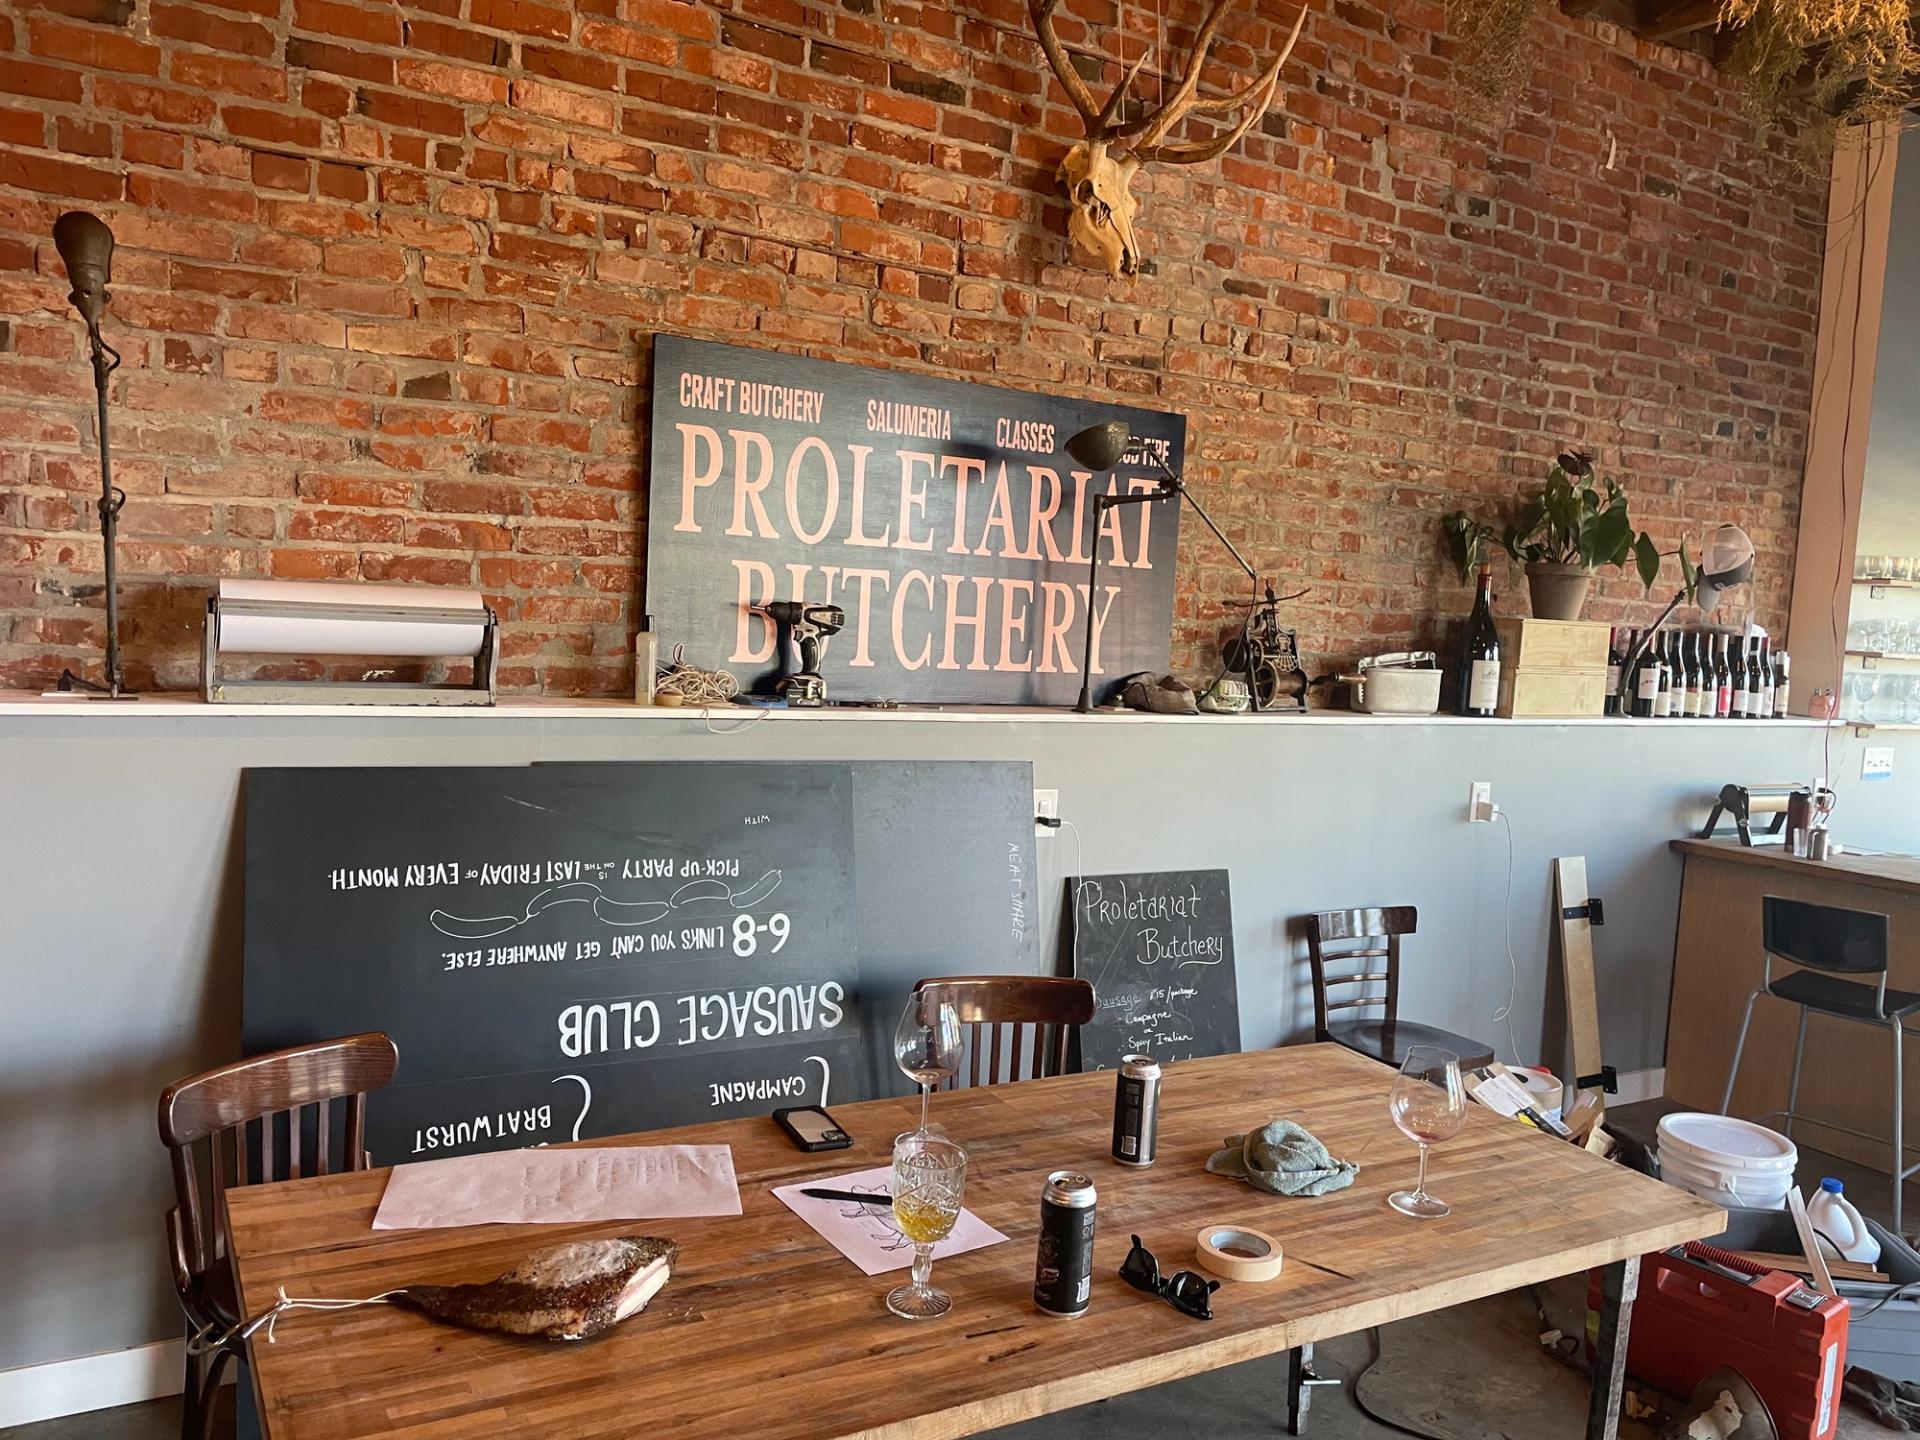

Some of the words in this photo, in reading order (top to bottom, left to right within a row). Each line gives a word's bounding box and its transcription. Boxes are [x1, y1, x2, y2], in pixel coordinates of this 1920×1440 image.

[680, 372, 735, 413] CRAFT
[739, 381, 824, 424] BUTCHERY
[867, 398, 951, 441] SALUMERIA
[996, 417, 1055, 454] CLASSES
[673, 422, 1167, 569] PROLETARIAT
[728, 559, 1121, 674] BUTCHERY
[744, 814, 770, 825] WITH
[404, 862, 459, 887] EVERY
[465, 869, 479, 879] OF
[480, 862, 541, 886] FRIDAY
[544, 860, 580, 883] LAST
[584, 863, 602, 871] THE
[622, 858, 673, 879] PARTY
[680, 859, 739, 878] PICK-UP
[651, 930, 676, 952] YOU
[681, 926, 724, 950] LINKS
[732, 912, 791, 957] 6-8
[441, 949, 482, 971] ELSE.
[486, 941, 568, 967] ANYWHERE
[575, 941, 600, 961] GET
[677, 981, 845, 1046] SAUSAGE
[558, 1000, 661, 1058] CLUB
[709, 1076, 806, 1106] CAMPAGNE
[411, 1104, 551, 1154] BRATWURST
